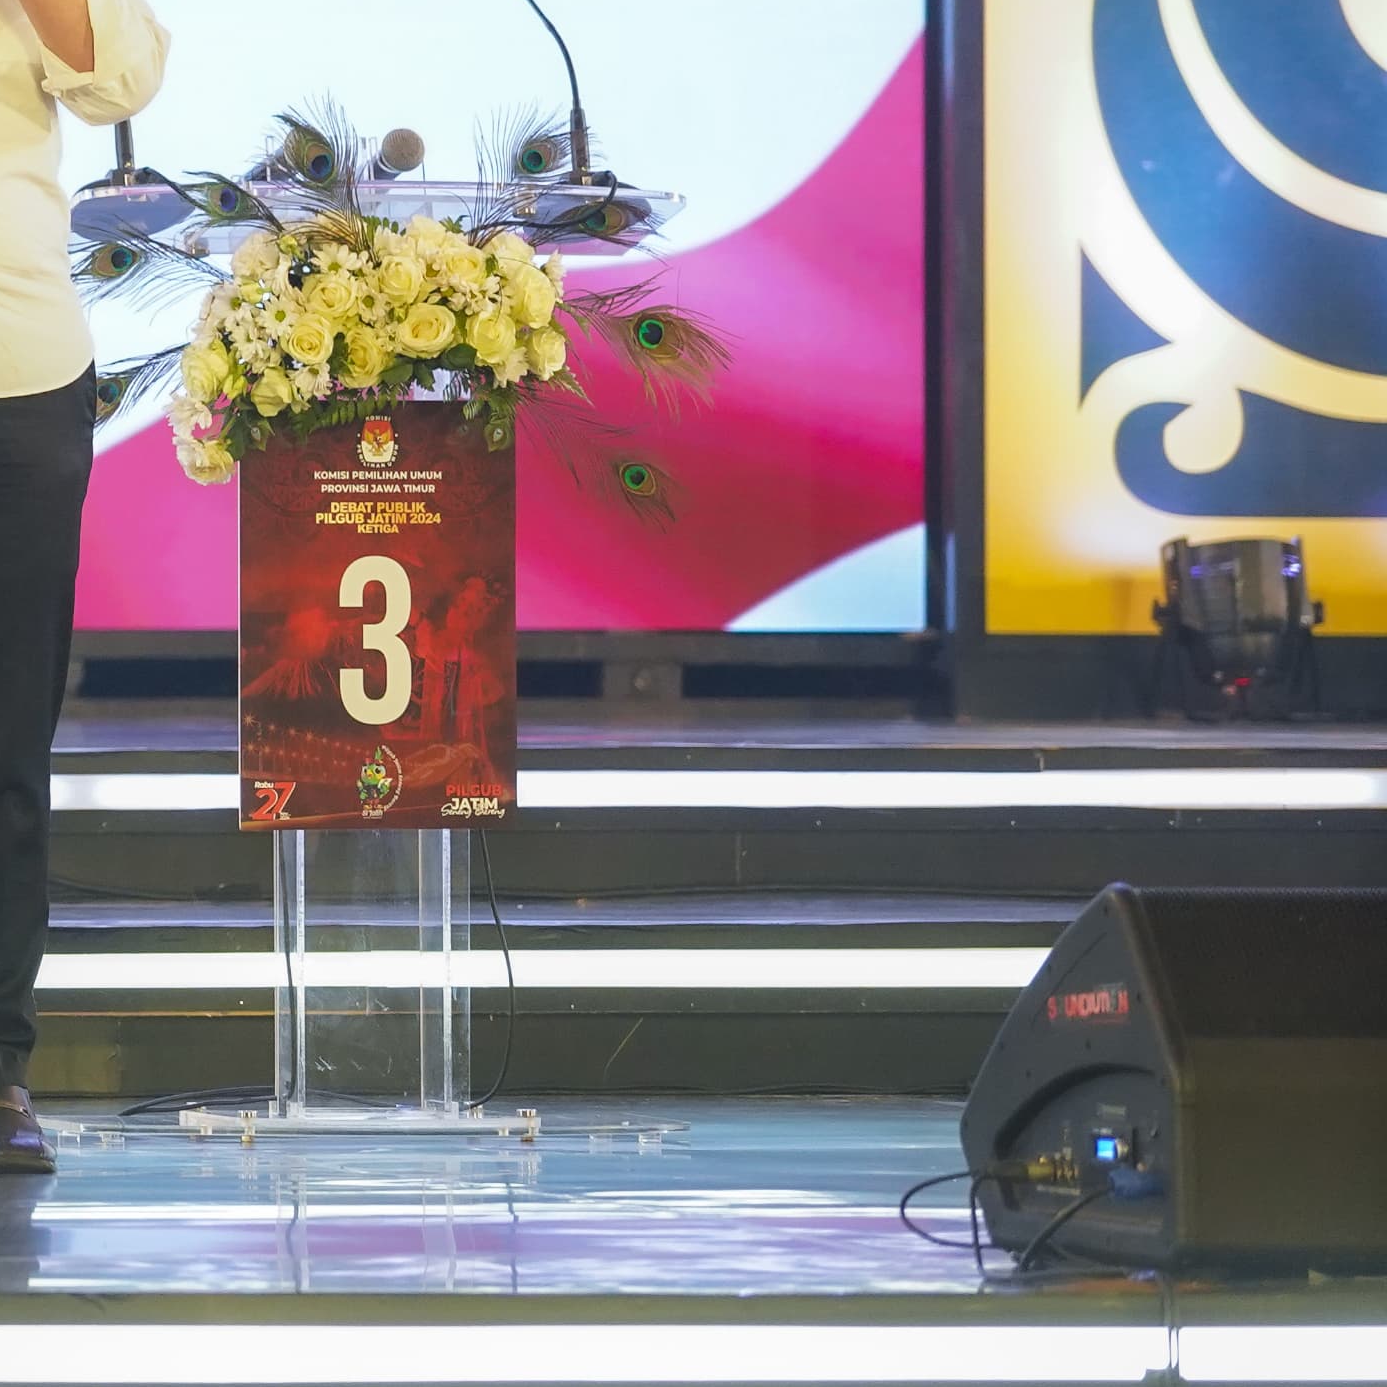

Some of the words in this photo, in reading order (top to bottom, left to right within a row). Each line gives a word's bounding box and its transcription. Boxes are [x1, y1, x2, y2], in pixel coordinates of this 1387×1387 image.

[314, 471, 349, 480] KOMISI
[352, 471, 407, 480] PEMILIHAN
[410, 471, 442, 480] UMUM
[321, 484, 368, 493] PROVINSI
[370, 484, 401, 493] JAWA
[403, 484, 435, 493] TIMUR
[330, 502, 373, 513] DEBAT
[377, 502, 426, 513] PUBLIK
[315, 513, 365, 524] PILGUB
[367, 513, 407, 524] JATIM
[410, 513, 442, 524] 2024
[357, 524, 399, 533] KETIGA
[339, 555, 412, 725] 3
[445, 784, 502, 797] PILGUB
[251, 781, 296, 821] 27
[452, 797, 498, 810] JATIM
